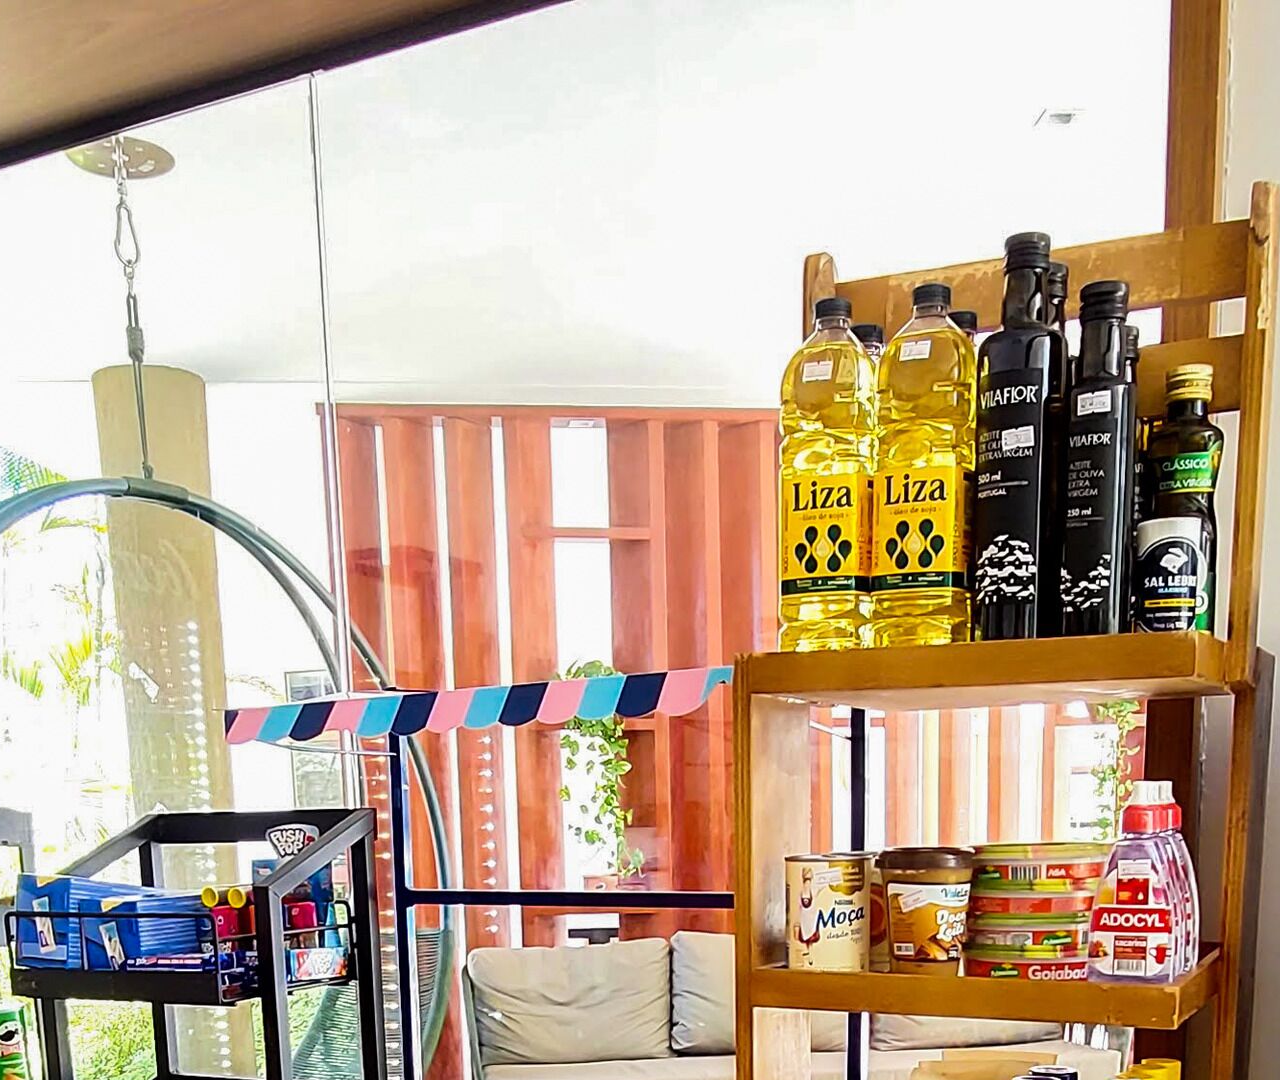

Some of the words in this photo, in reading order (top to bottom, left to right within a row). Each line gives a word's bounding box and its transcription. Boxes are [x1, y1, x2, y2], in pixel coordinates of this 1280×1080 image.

[793, 480, 853, 512] Liza
[884, 473, 947, 506] Liza
[816, 905, 865, 928] Moça
[1099, 912, 1166, 928] ADOCYL
[1028, 965, 1088, 981] Goiabad
